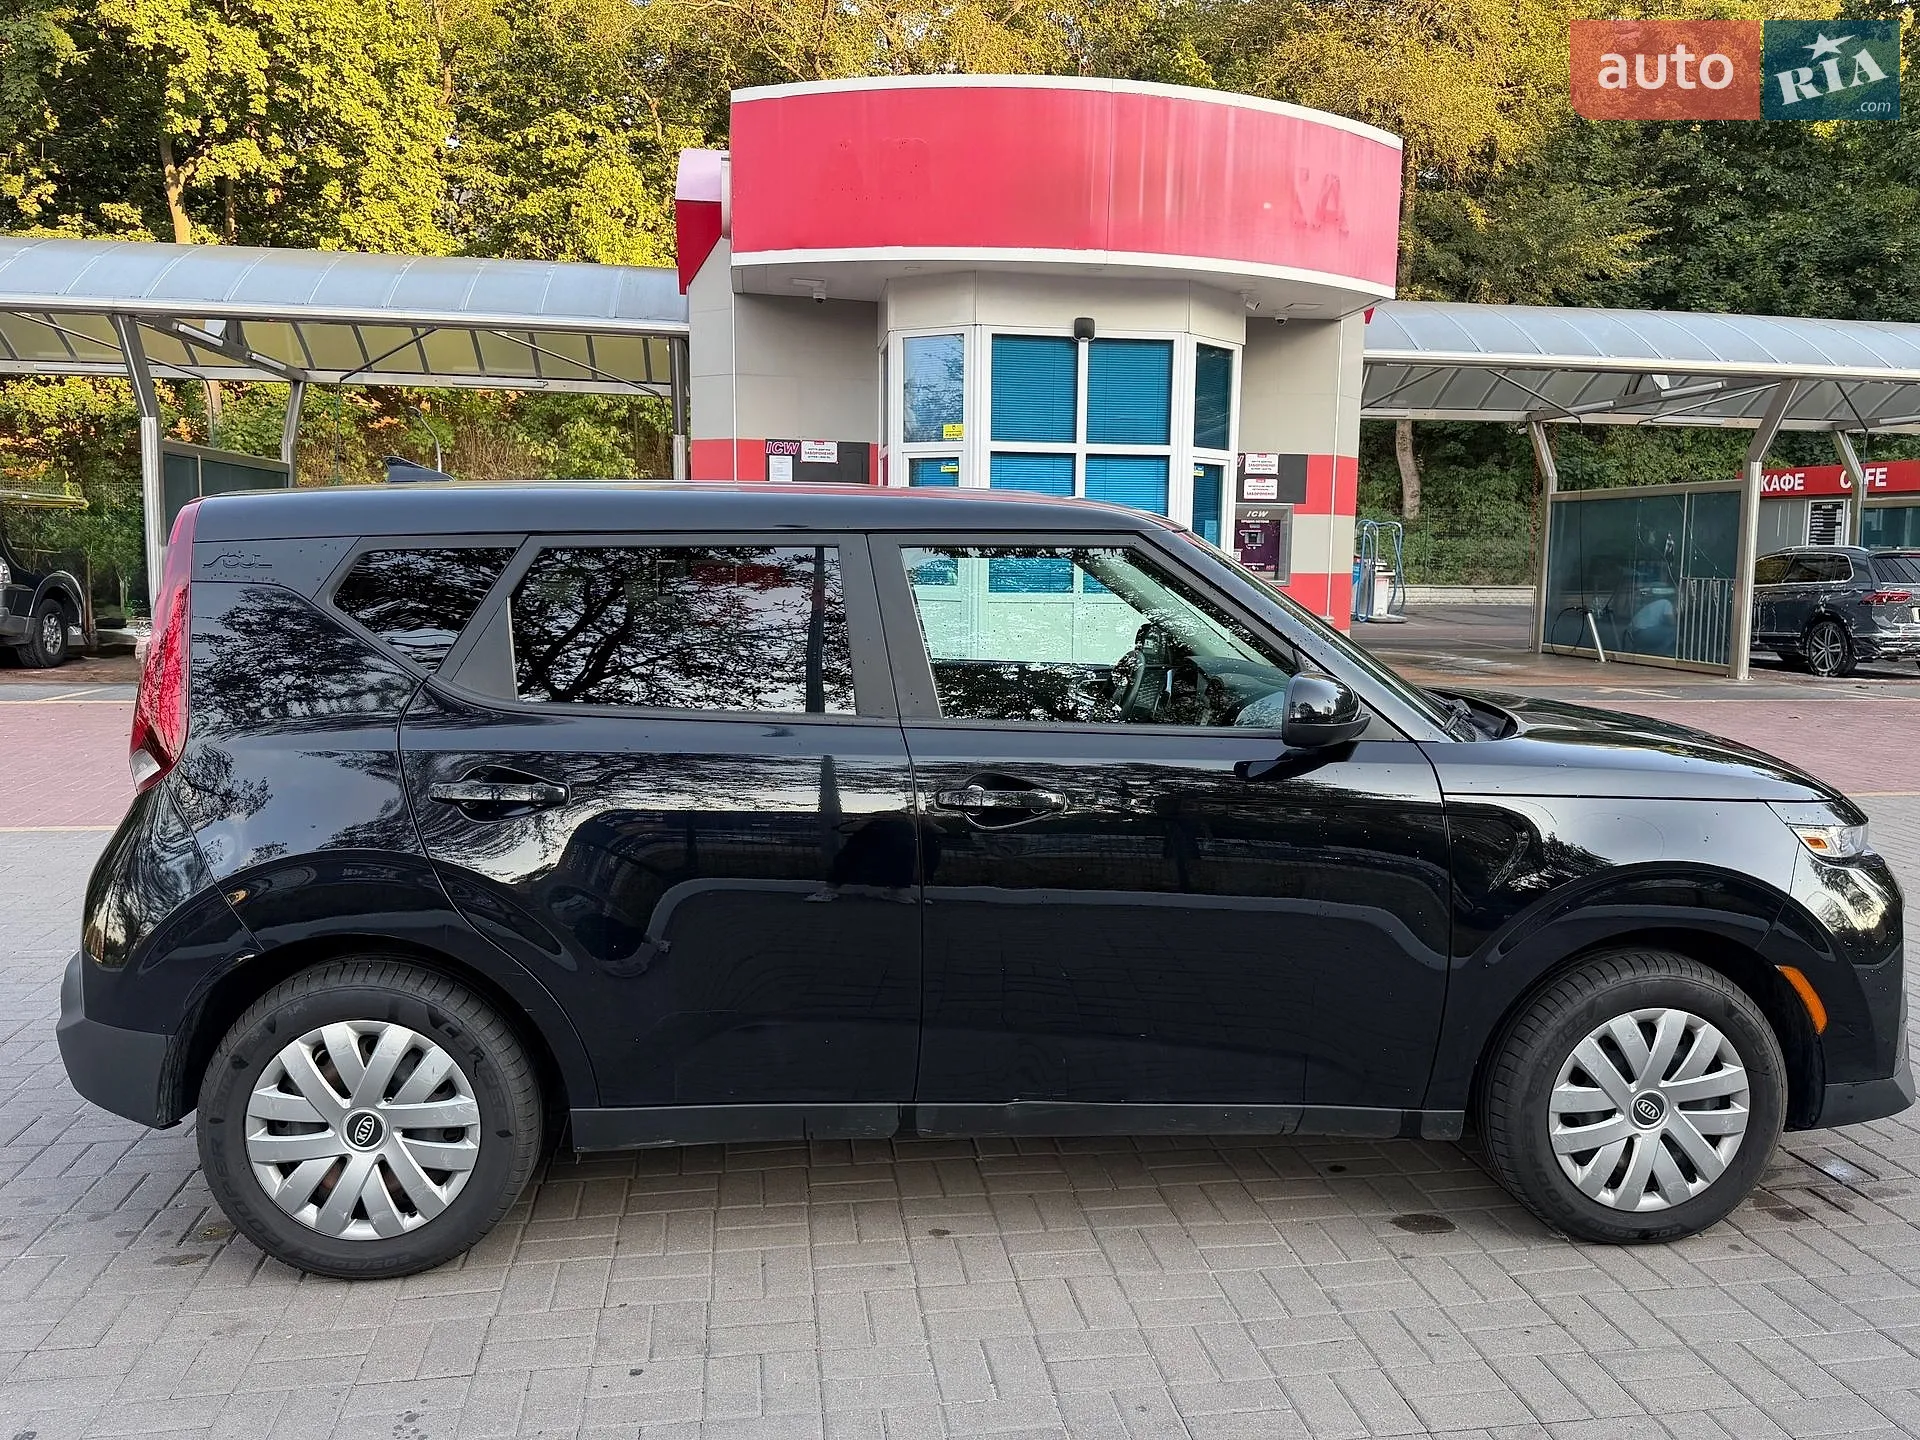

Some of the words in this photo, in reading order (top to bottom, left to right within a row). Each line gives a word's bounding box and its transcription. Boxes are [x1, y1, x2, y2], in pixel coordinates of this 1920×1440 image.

[765, 441, 800, 455] ICW
[1760, 473, 1805, 492] КАФЕ
[1839, 467, 1888, 489] CFE
[1246, 510, 1269, 518] ICW
[1639, 1101, 1657, 1117] KIA
[356, 1120, 373, 1141] KIA
